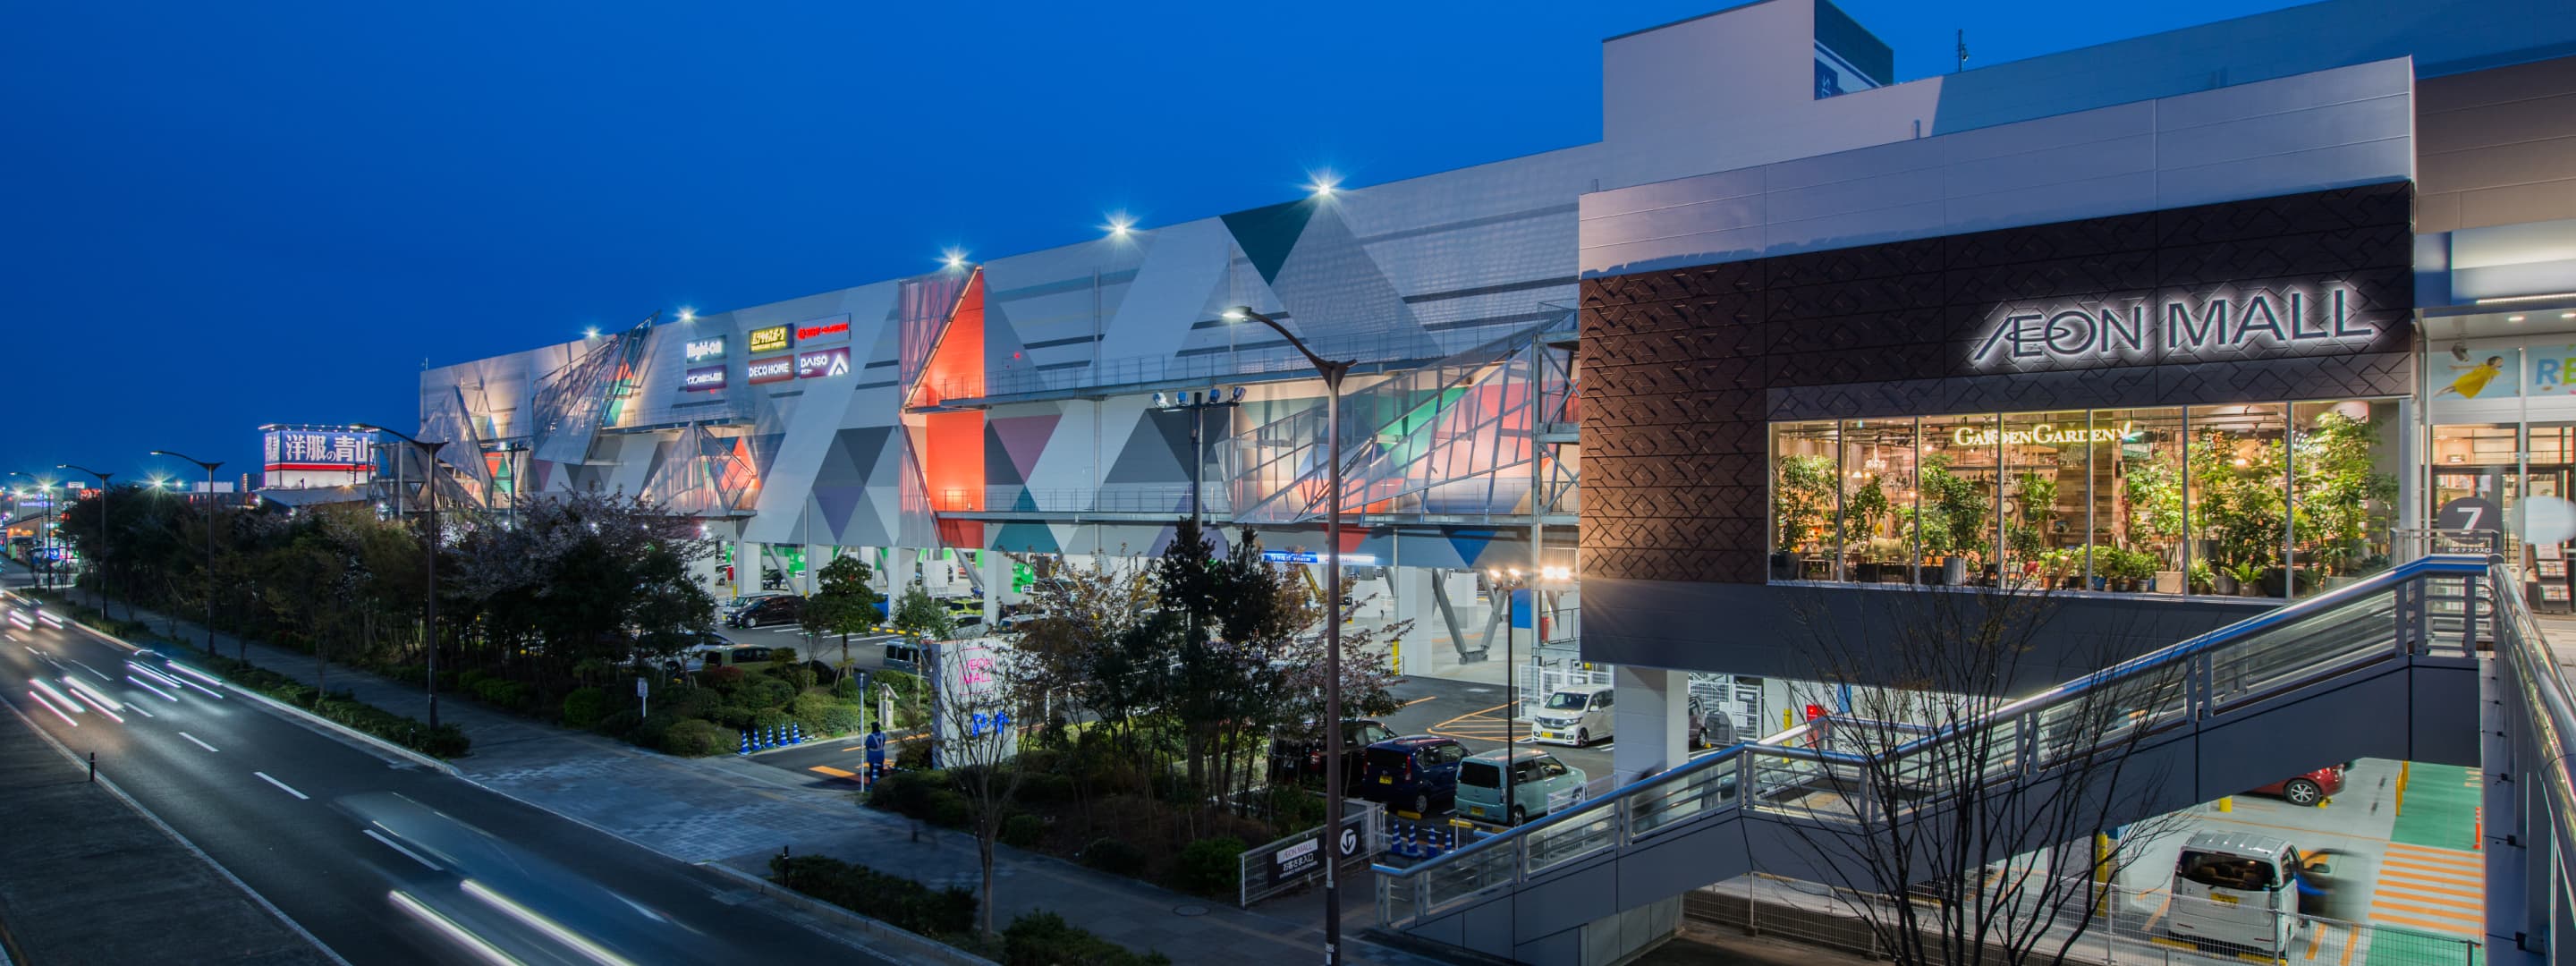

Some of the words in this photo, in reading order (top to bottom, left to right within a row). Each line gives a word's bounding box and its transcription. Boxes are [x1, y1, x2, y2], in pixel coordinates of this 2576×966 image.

[2167, 288, 2373, 350] MALL
[749, 364, 768, 377] DECO
[768, 361, 790, 375] HOME
[801, 355, 827, 368] DAISO
[286, 434, 375, 462] 洋服の青山
[2457, 506, 2483, 535] 7
